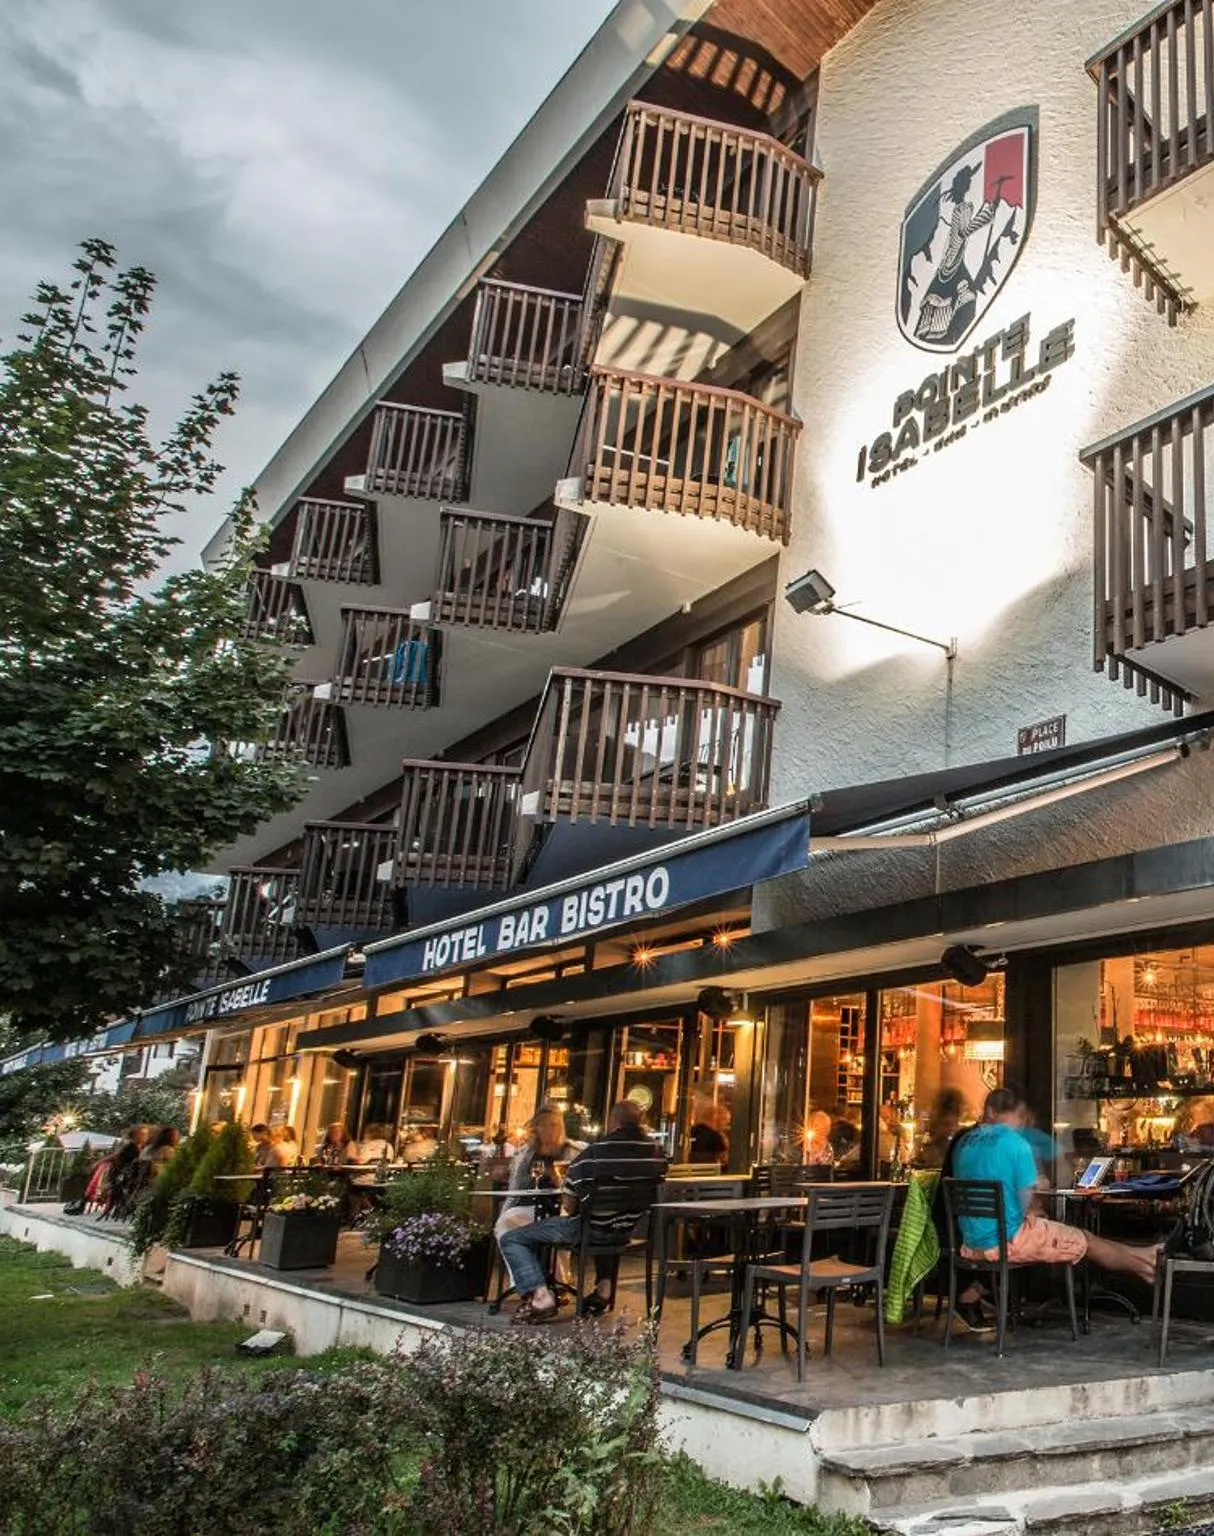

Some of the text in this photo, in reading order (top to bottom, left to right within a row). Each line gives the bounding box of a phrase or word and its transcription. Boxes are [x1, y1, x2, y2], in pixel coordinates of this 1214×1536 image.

[856, 317, 1076, 483] ISABELLE
[892, 311, 1031, 428] POINTE
[1031, 722, 1058, 742] PLACE
[422, 866, 670, 971] HOTEL BAR BISTRO
[218, 978, 273, 1014] ISABELLE
